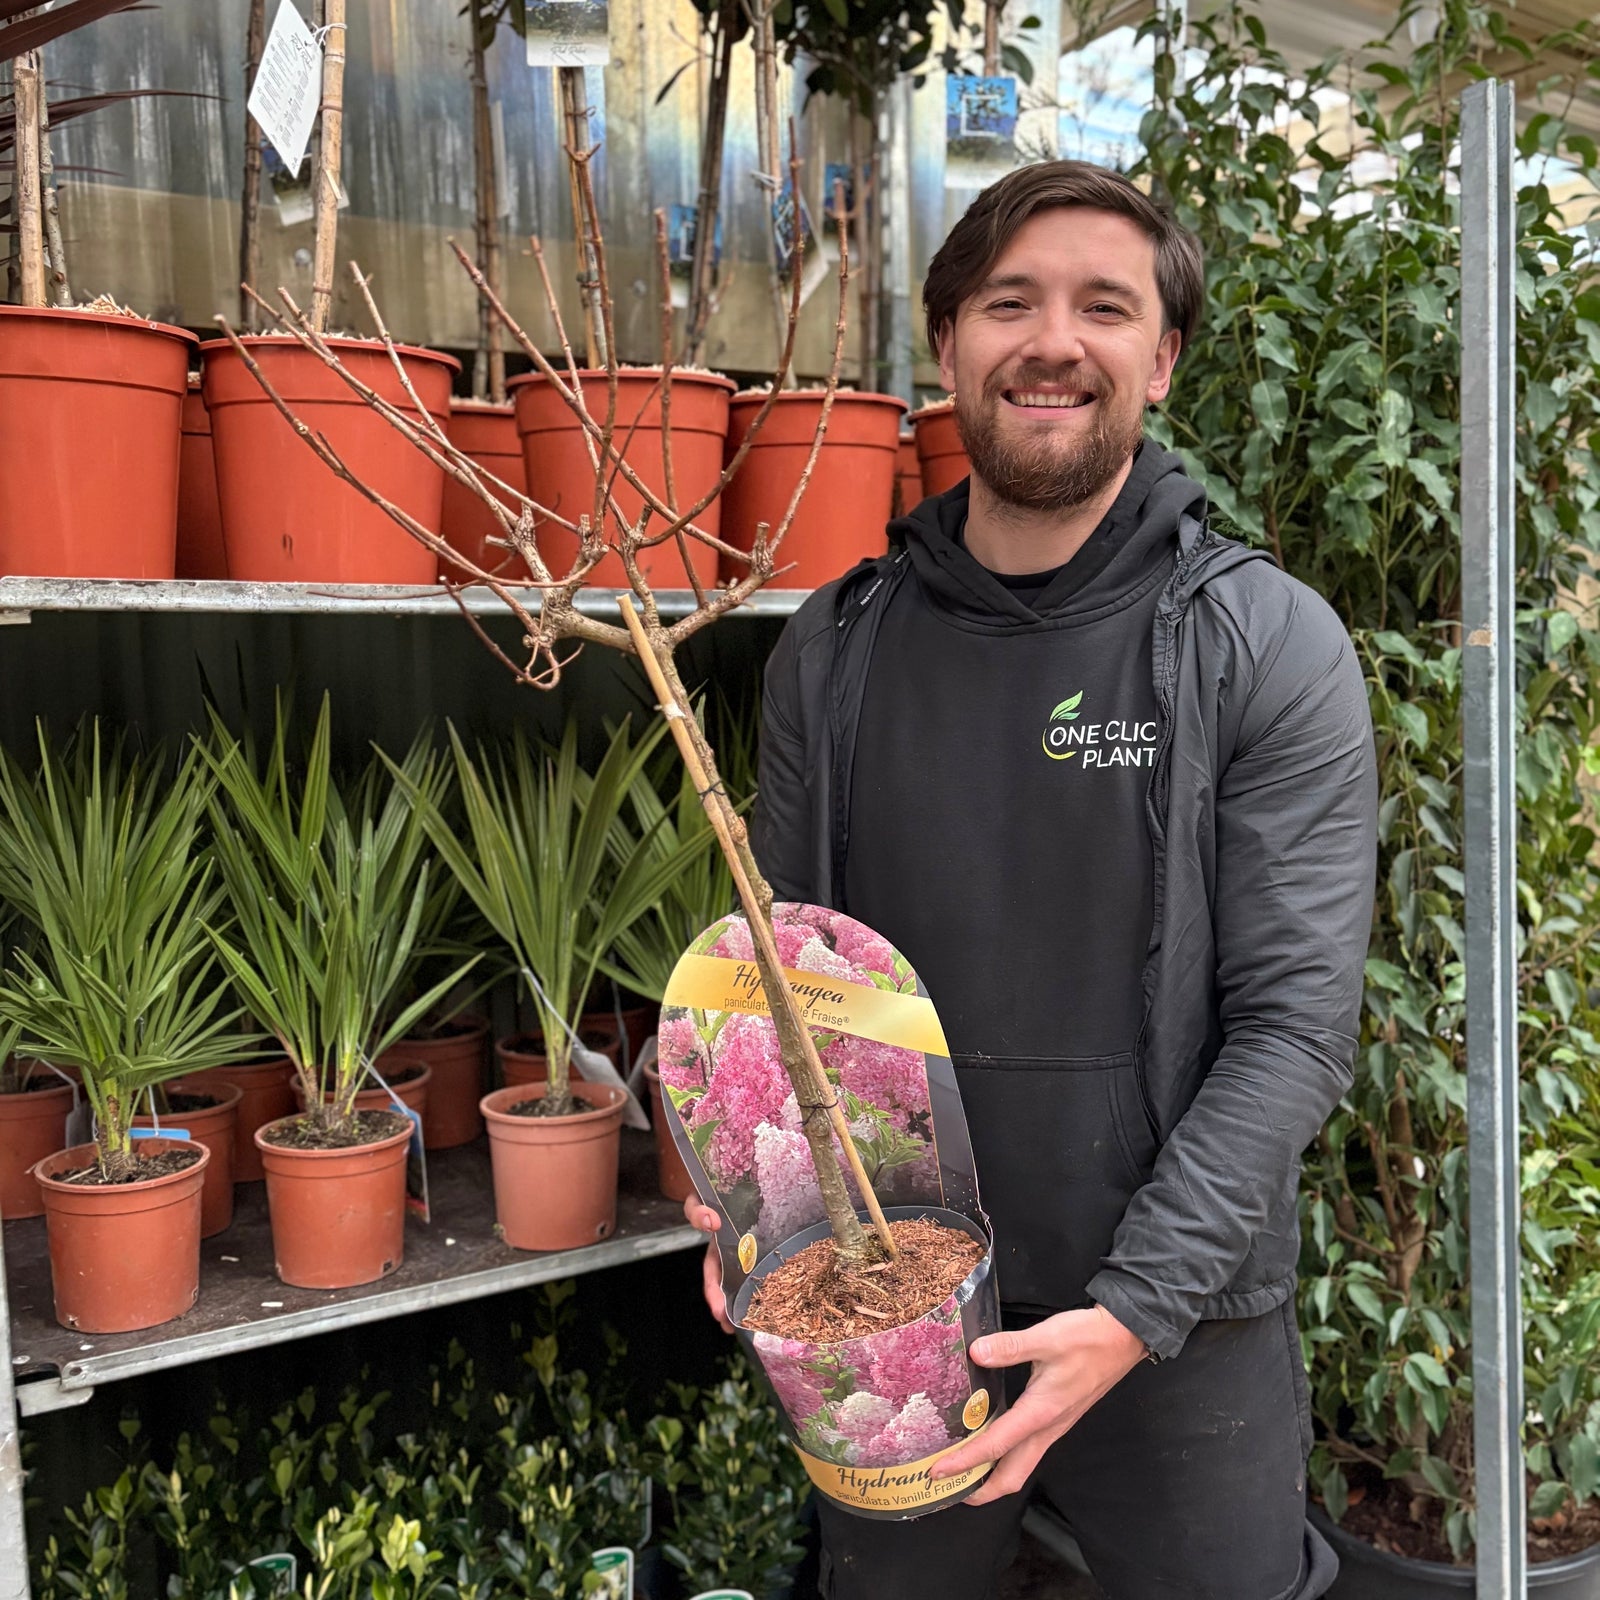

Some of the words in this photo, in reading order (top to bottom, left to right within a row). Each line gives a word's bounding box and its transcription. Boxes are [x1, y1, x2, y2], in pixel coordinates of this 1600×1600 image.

[1050, 724, 1101, 747] ONE
[1105, 720, 1156, 742] CLIC
[732, 963, 846, 1008] Hyangea
[837, 1467, 932, 1496] Hydrang
[892, 1490, 931, 1506] Vanille
